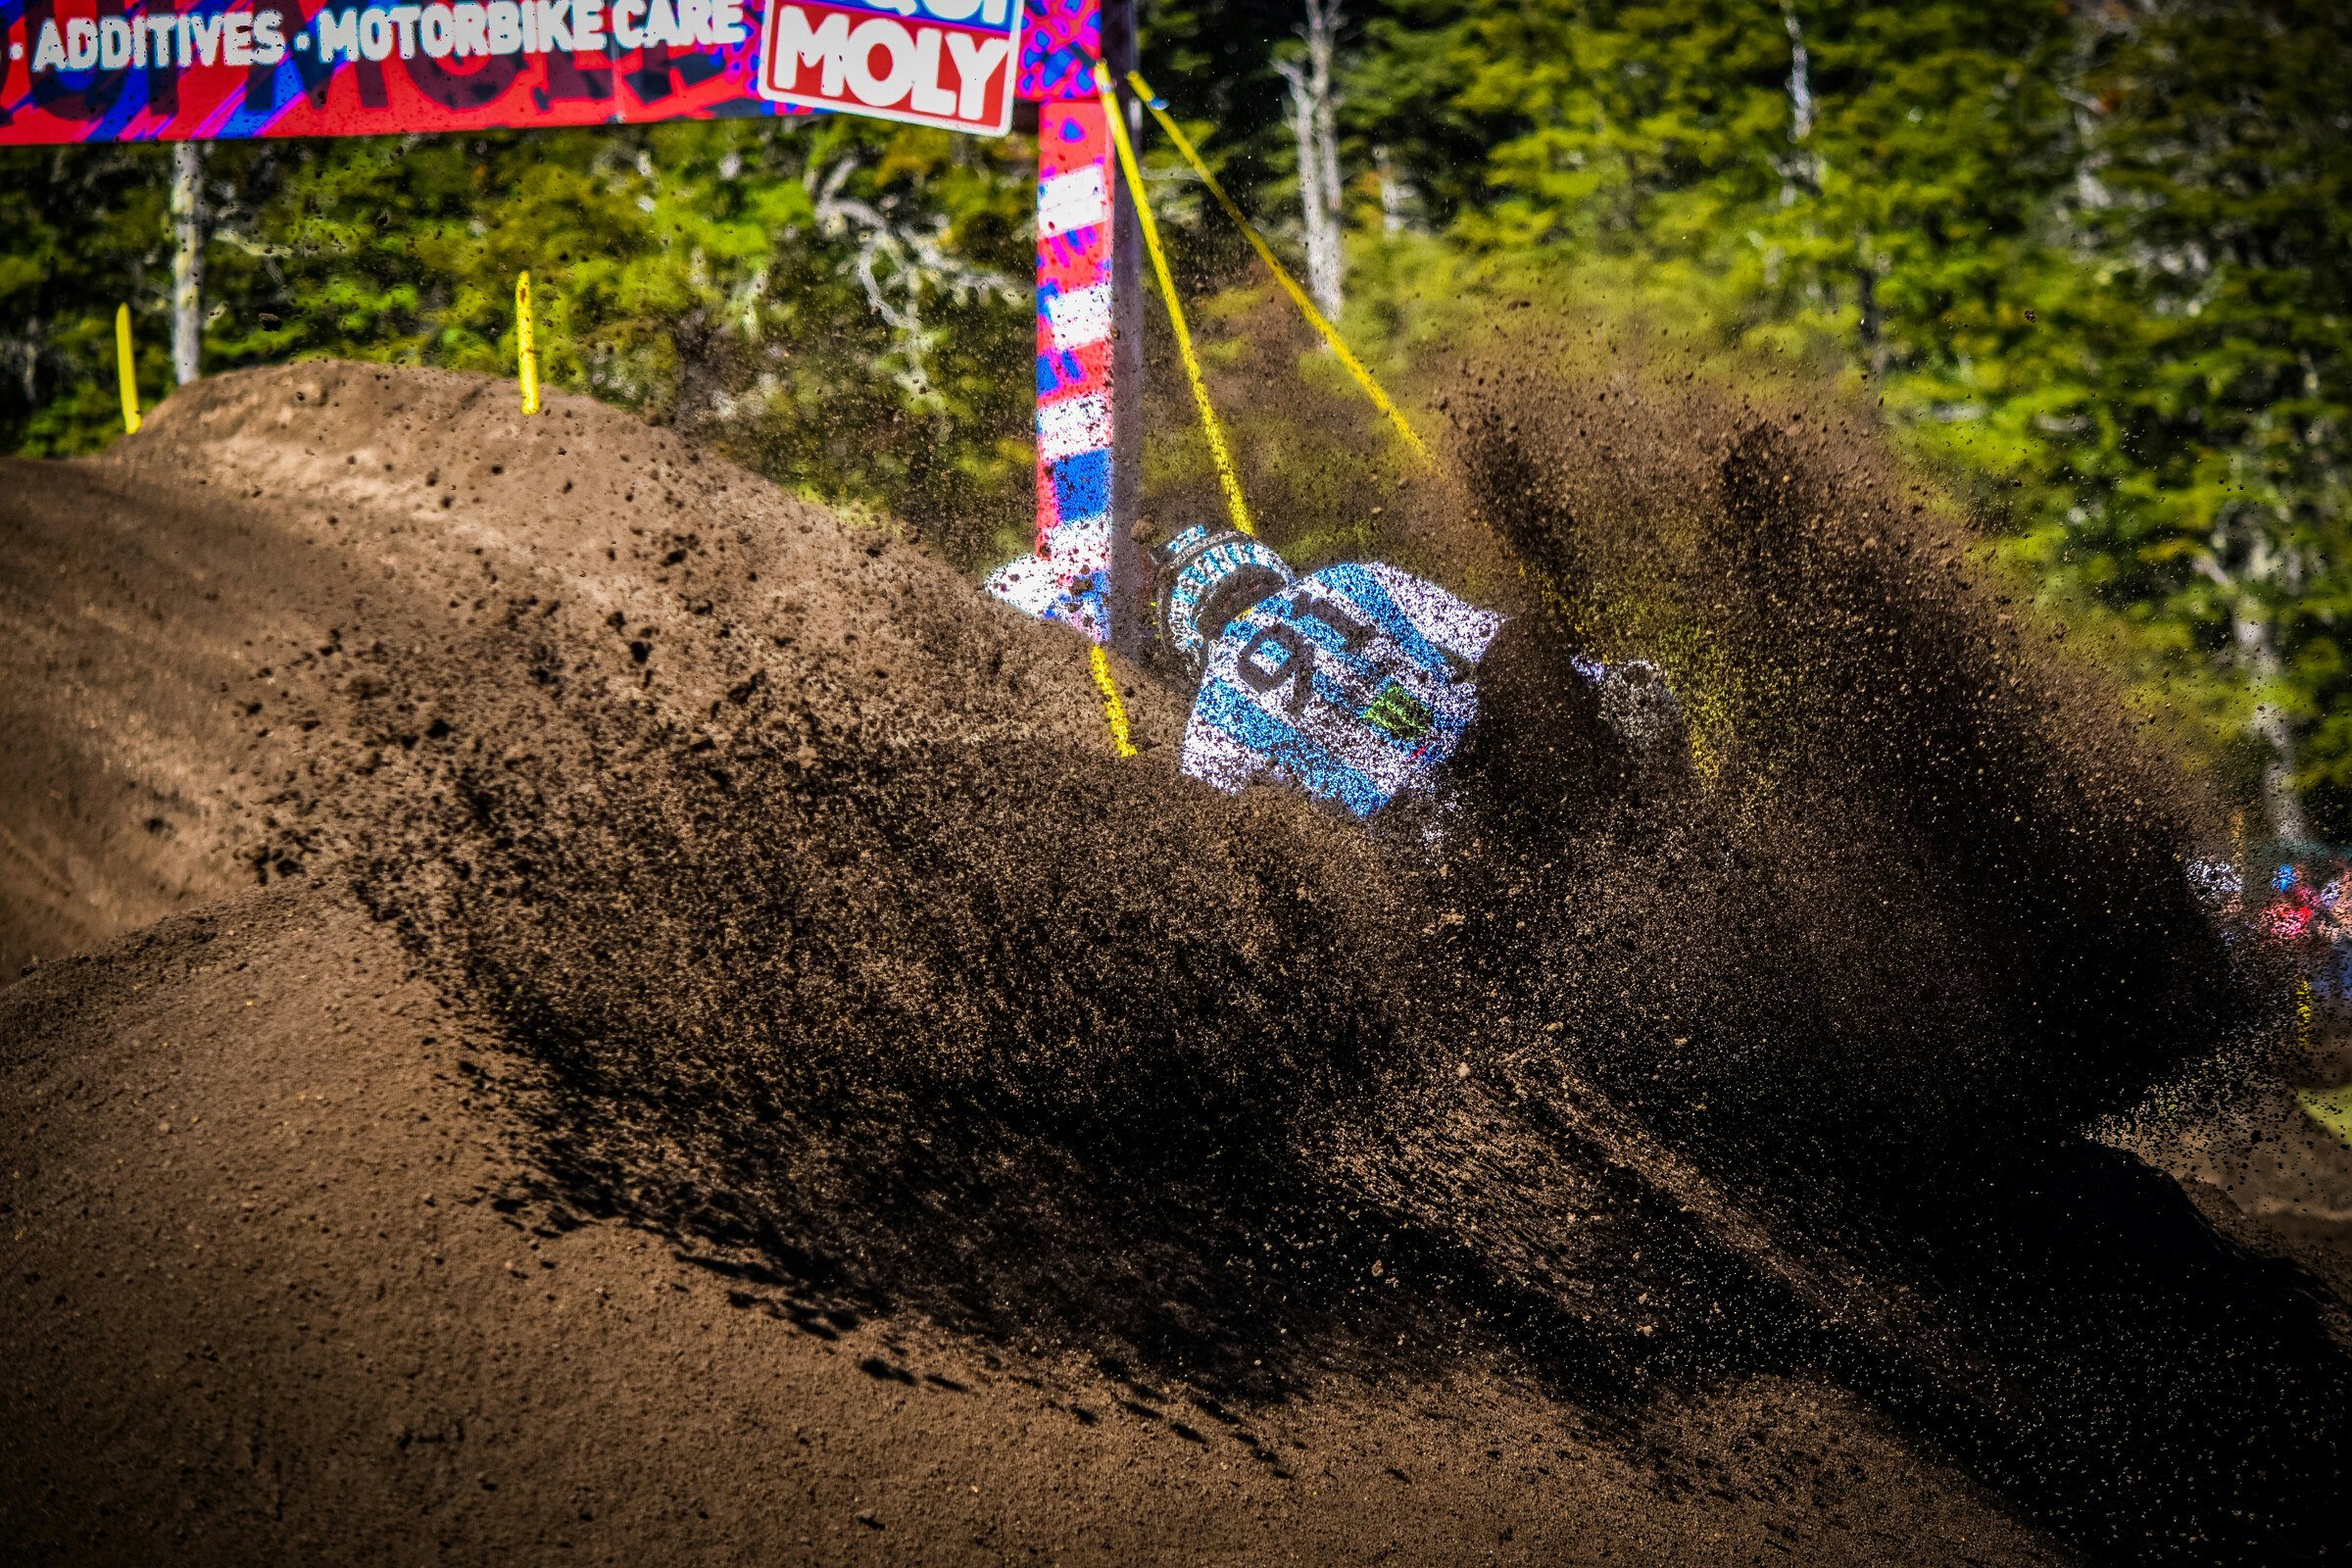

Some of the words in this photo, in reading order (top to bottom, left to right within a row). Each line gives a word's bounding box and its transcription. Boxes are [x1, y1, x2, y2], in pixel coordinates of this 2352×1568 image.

[31, 9, 285, 73] ADDITIVES
[318, 0, 607, 64] MOTORBIKE
[612, 0, 746, 50] CARE
[773, 5, 1009, 122] MOLY
[1237, 592, 1376, 713] 91
